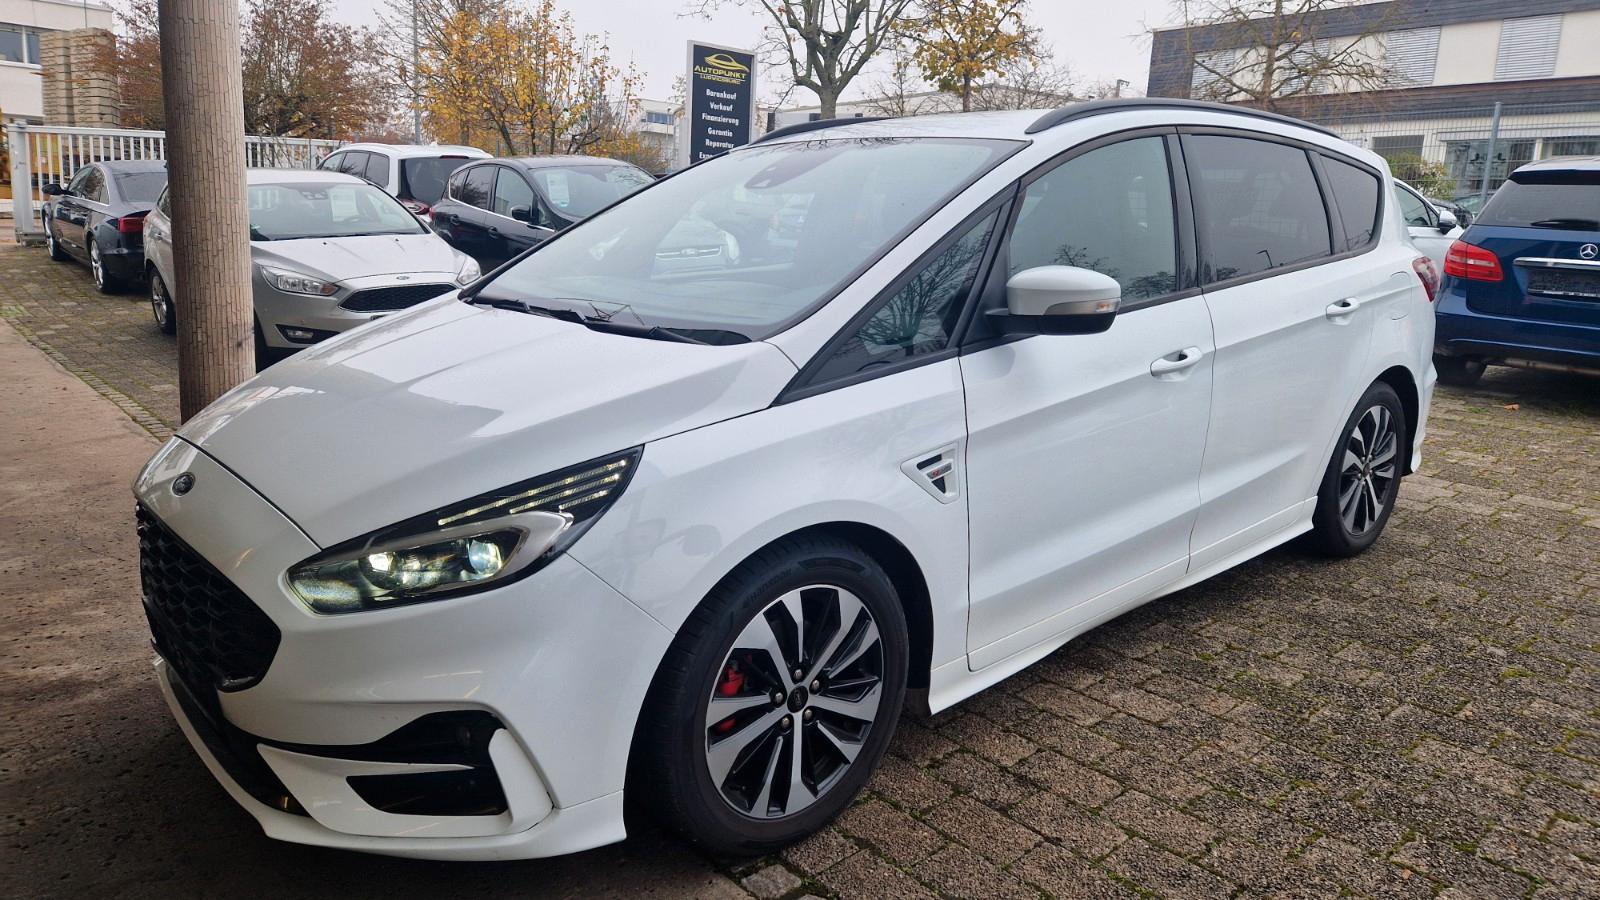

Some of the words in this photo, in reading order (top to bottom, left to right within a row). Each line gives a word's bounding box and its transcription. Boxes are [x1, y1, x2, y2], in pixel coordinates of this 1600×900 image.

[694, 65, 746, 79] AUTOPUNKT
[709, 101, 733, 112] Verkauf
[702, 112, 739, 126] Finanzierung
[707, 127, 733, 137] Garantie
[705, 138, 734, 149] Reparatur
